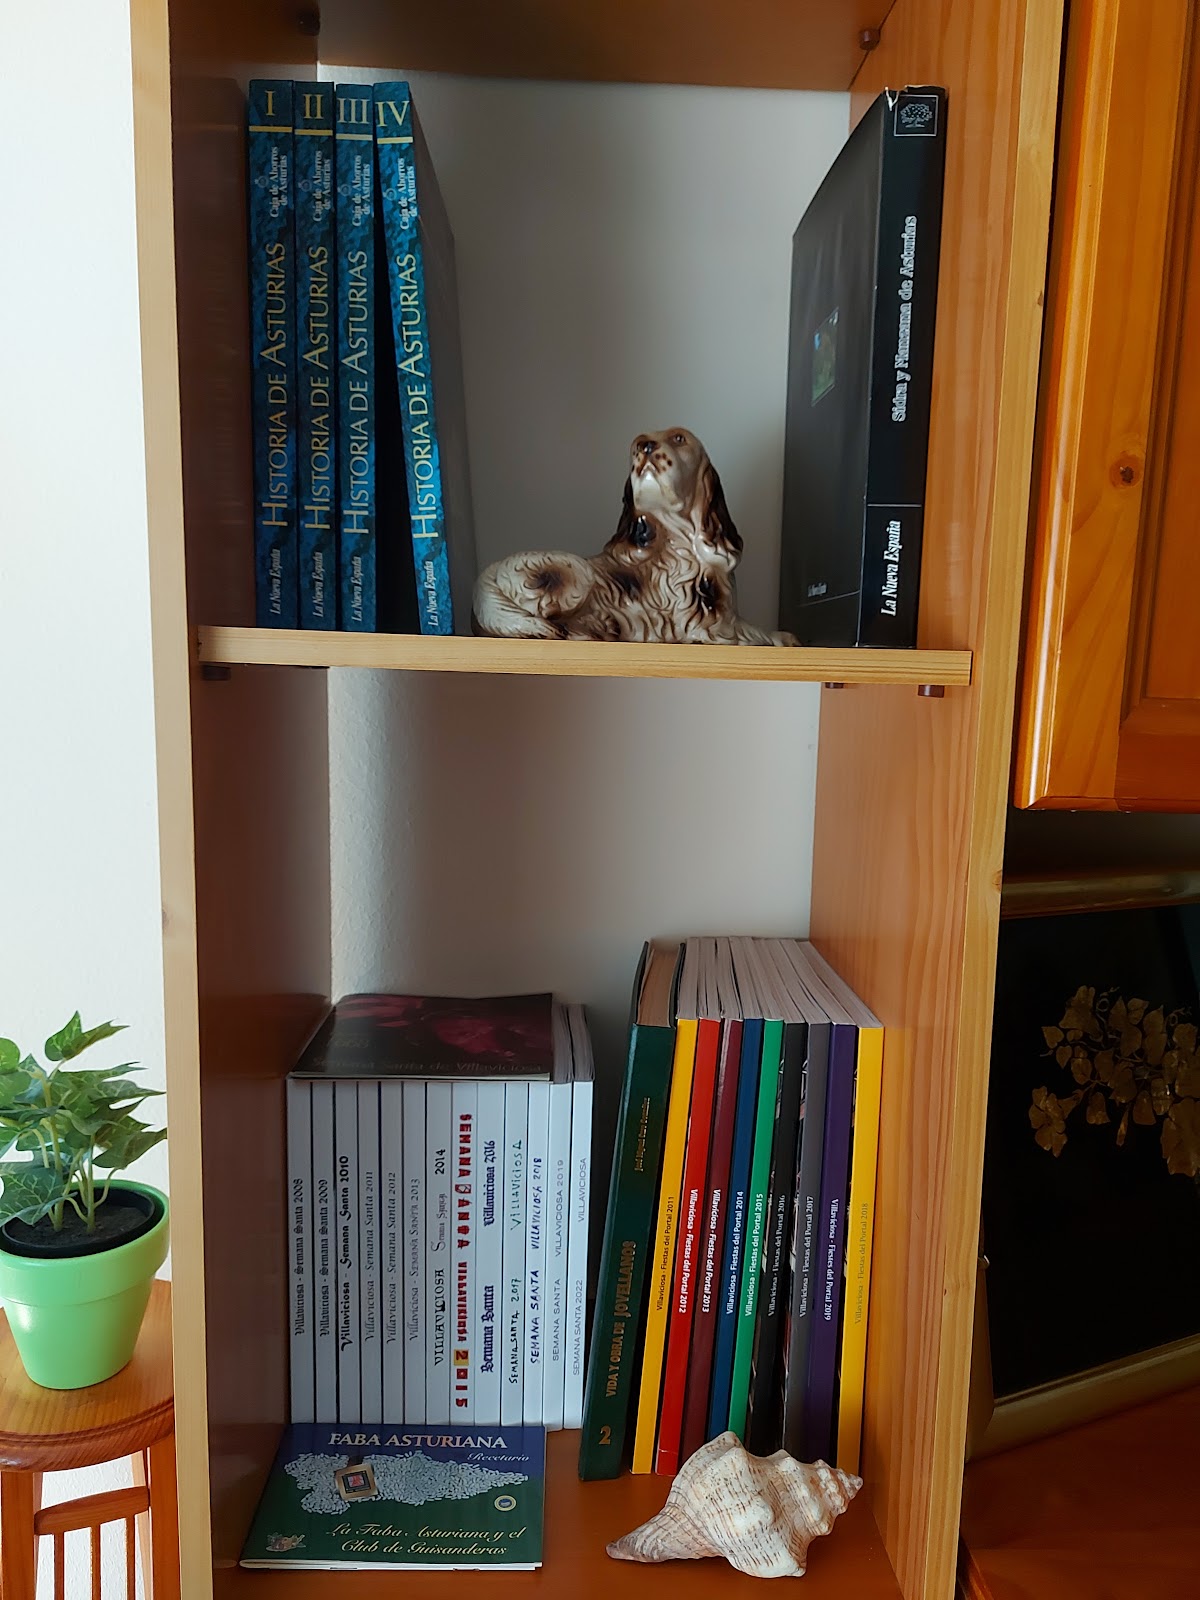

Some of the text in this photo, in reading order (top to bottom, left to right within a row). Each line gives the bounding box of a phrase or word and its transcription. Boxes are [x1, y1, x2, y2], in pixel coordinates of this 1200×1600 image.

[303, 94, 324, 119] II
[337, 98, 370, 124] III
[375, 101, 410, 126] IV
[270, 147, 278, 182] Ahorros
[279, 155, 287, 192] Asturias
[313, 151, 322, 185] Ahorros
[322, 159, 331, 196] Asturias
[353, 155, 361, 190] Ahorros
[361, 164, 370, 201] Asturias
[397, 158, 405, 195] Ahorros
[406, 165, 416, 204] Asturias
[890, 215, 917, 422] Sidra Manzana de Asturias
[260, 242, 288, 526] HISTORIA DE ASTURIAS
[302, 246, 330, 530] HISTORIA DE ASTURIAS
[341, 250, 369, 534] HISTORIA DE ASTURIAS
[396, 254, 439, 538] HISTORIA DE ASTURIAS
[270, 549, 282, 614] La Nueva España
[312, 552, 324, 617] La Nueva España
[351, 556, 363, 621] La Nueva España
[423, 561, 439, 626] La Nueva España
[881, 520, 902, 617] La Nueva España
[457, 1114, 472, 1177] SEMANA
[532, 1158, 542, 1180] 2018
[805, 1214, 813, 1235] Portal
[806, 1196, 814, 1212] 2017
[830, 1199, 839, 1238] Villaviciosa
[294, 1178, 306, 1336] Villaviciosa Semana Santa 2008
[319, 1179, 330, 1337] Villaviciosa Semana Santa 2009
[340, 1156, 353, 1351] Villaviciosa Semana Santa 2010
[364, 1171, 376, 1341] Villaviciosa Semana Santa 2011
[387, 1172, 398, 1344] Villaviciosa Semana Santa 2012
[409, 1178, 420, 1341] Villaviciosa SEMANA SANTA 2013
[434, 1149, 446, 1366] VILLAVICIOSA 2014
[481, 1140, 498, 1372] Semana Santa Villaviciosa 2016
[552, 1160, 564, 1361] SEMANA SANTA VILLAVICIOSA 2019
[572, 1158, 587, 1376] SEMANA SANTA 2022 VILLAVICIOSA
[656, 1196, 674, 1311] Villaviciosa Fiestas del Portal 2011
[679, 1189, 698, 1313] Villaviciosa Fiestas del Portal 2012
[702, 1189, 721, 1312] Villaviciosa Fiestas del Portal 2013
[726, 1191, 744, 1314] Villaviciosa Fiestas del Portal 2014
[745, 1193, 763, 1316] Villaviciosa Fiestas del Portal 2015
[768, 1195, 786, 1316] Villaviciosa Fiestas del Portal 2016
[802, 1249, 810, 1272] Fiestas
[826, 1269, 834, 1280] del
[827, 1244, 836, 1268] Fiestes
[857, 1256, 865, 1279] Fiestas
[530, 1270, 540, 1310] SANTA
[800, 1278, 808, 1317] Villaviciosa
[825, 1282, 833, 1302] Portal
[854, 1285, 863, 1324] Villaviciosa
[530, 1317, 540, 1364] SEMANA
[606, 1240, 636, 1397] VIDA OBRA DE JOVELLANOS
[454, 1350, 469, 1408] 2015
[328, 1433, 508, 1449] FABA ASTURIANA
[467, 1452, 530, 1462] Recetario
[598, 1425, 612, 1445] 2
[326, 1523, 351, 1537] La
[356, 1523, 401, 1537] Faba
[510, 1526, 527, 1539] el
[341, 1540, 508, 1555] Club de Guisanderas
